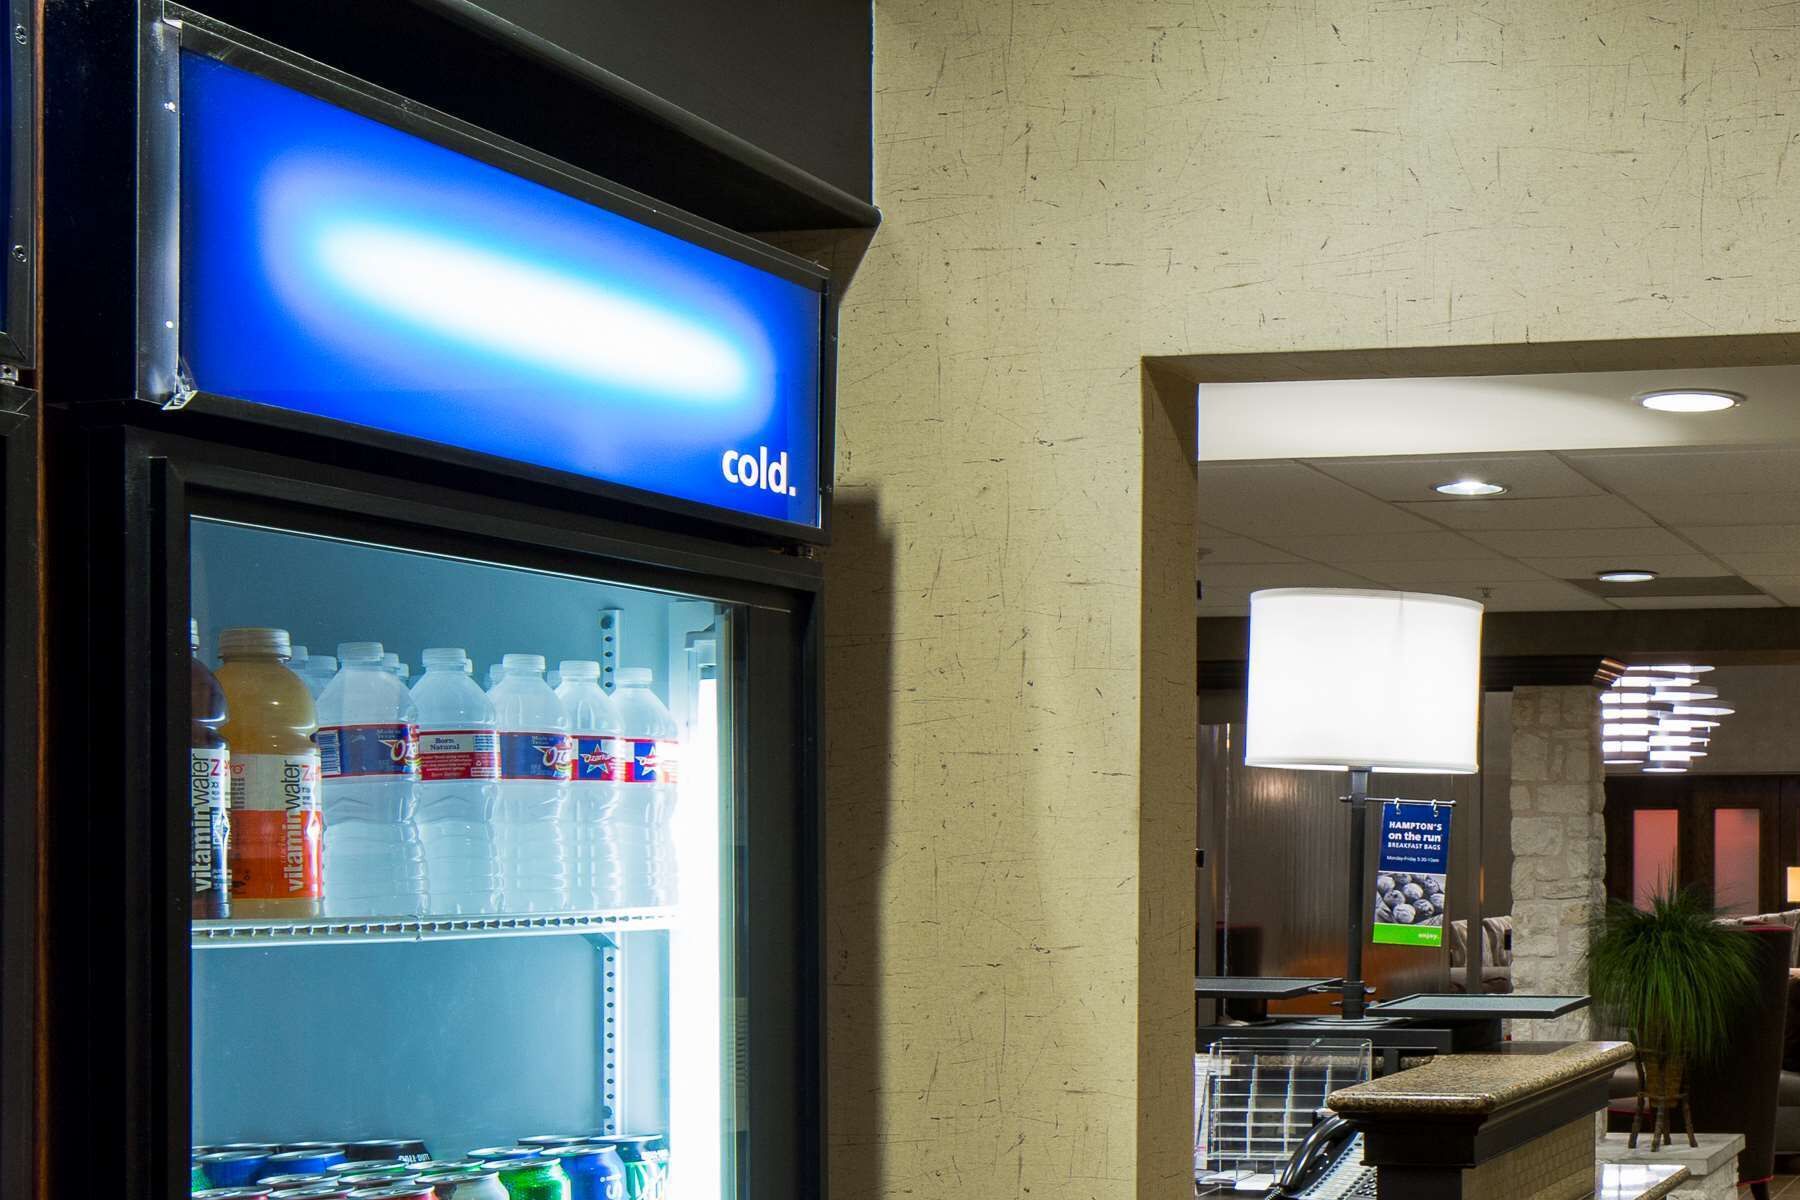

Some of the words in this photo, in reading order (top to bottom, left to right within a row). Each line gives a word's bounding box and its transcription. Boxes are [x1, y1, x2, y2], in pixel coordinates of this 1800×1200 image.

[722, 445, 796, 497] cold.
[429, 743, 461, 751] Natural
[191, 752, 213, 893] vitaminwater
[280, 759, 305, 893] vitaminwater
[1388, 820, 1443, 832] HAMPTON'S
[1387, 832, 1402, 841] on
[1403, 831, 1422, 842] the
[1422, 834, 1442, 843] run
[1387, 842, 1422, 850] BREAKFAST
